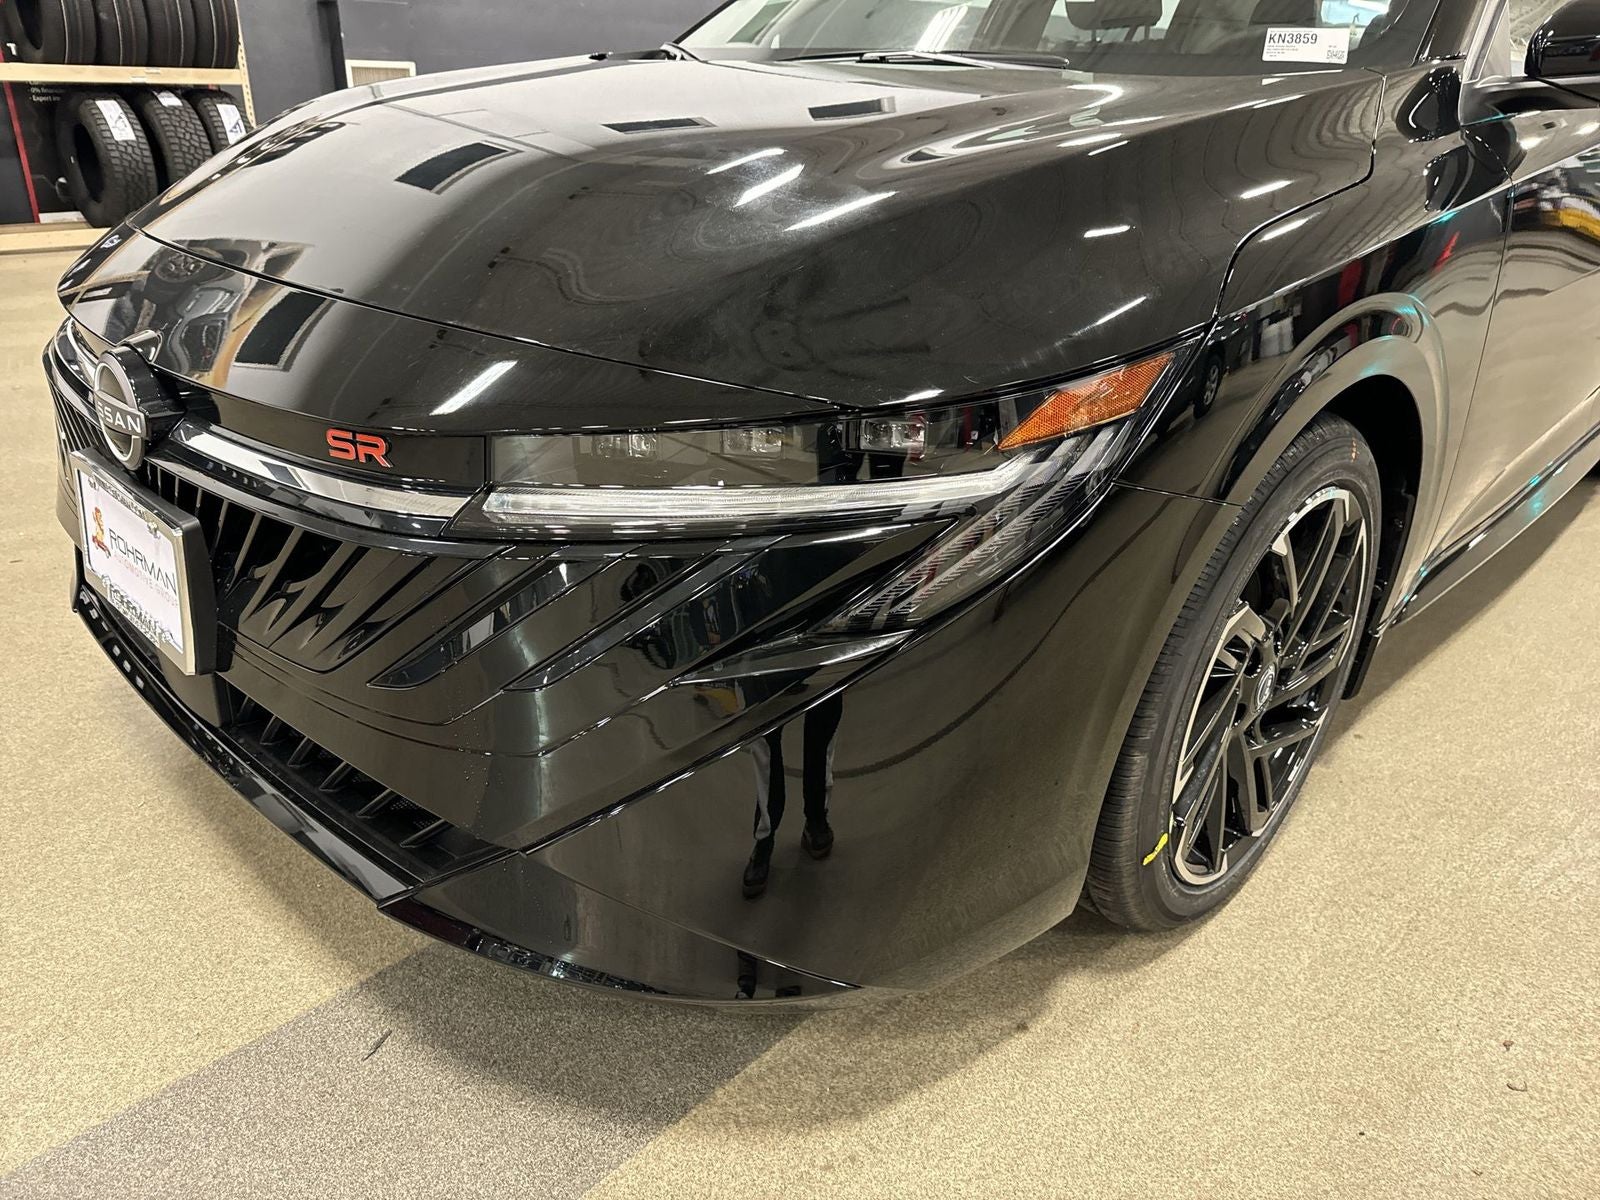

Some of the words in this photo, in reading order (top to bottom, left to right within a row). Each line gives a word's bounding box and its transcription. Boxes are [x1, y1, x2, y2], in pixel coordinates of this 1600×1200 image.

[1268, 33, 1318, 44] KN3859
[326, 428, 393, 468] SR
[109, 528, 177, 596] ROHRMAN
